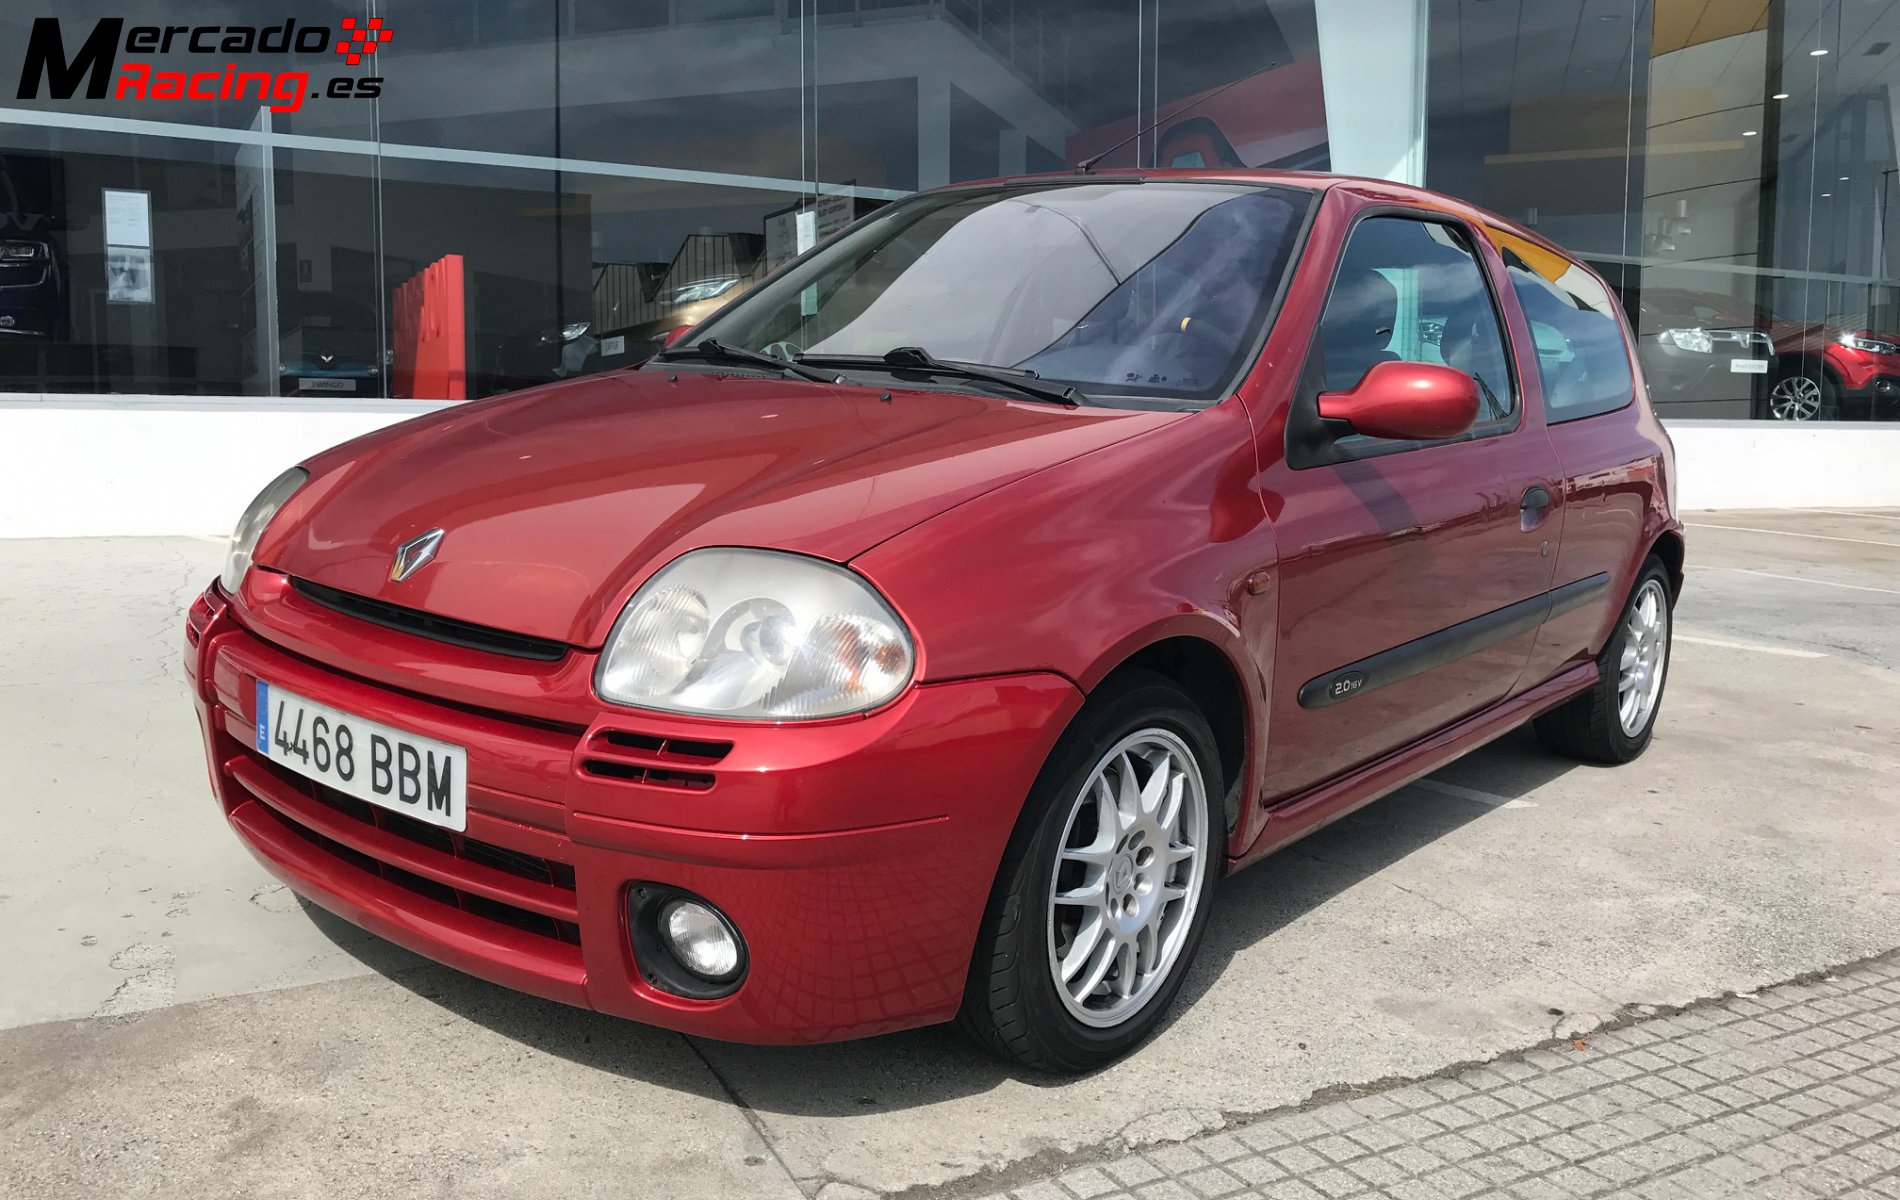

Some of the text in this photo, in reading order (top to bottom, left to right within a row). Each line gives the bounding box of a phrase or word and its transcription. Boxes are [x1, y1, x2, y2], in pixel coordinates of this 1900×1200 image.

[260, 723, 266, 741] E
[274, 700, 452, 817] 4468 BBM
